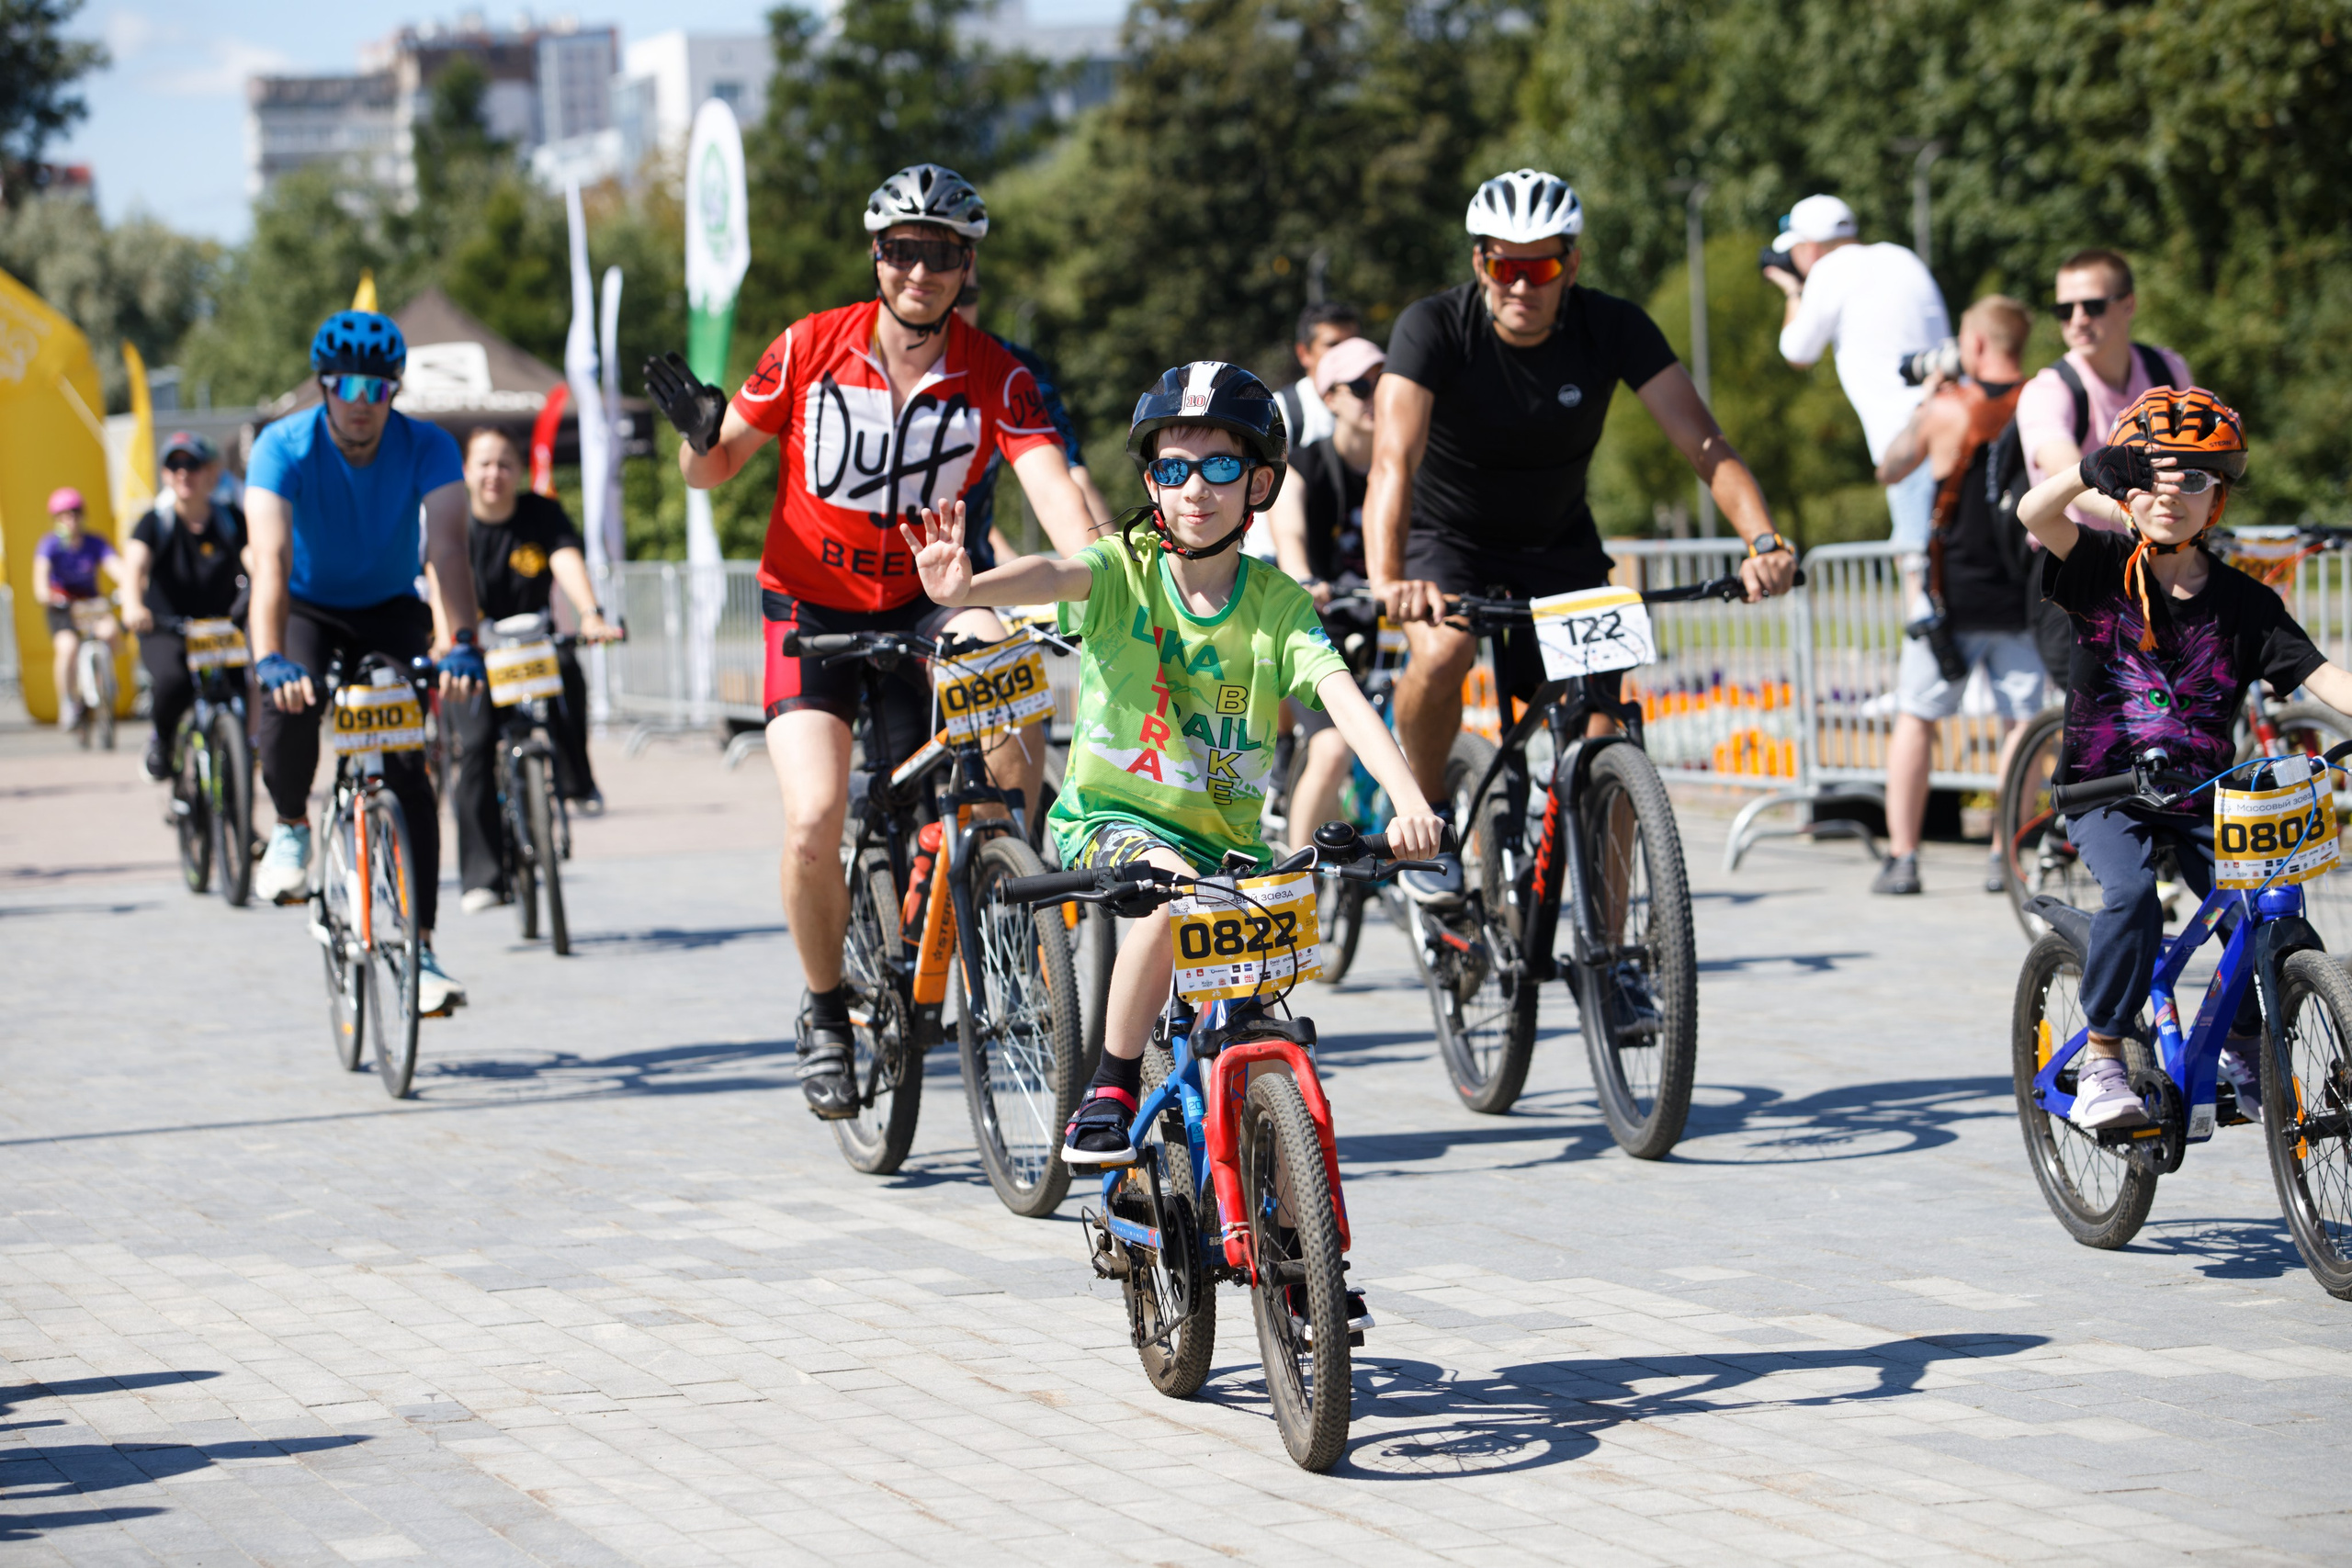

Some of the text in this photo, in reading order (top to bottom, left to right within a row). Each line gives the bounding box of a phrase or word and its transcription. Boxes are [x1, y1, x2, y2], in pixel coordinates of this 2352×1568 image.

[1186, 394, 1205, 407] 10
[816, 369, 974, 529] Duff
[821, 537, 917, 577] BEE
[1131, 604, 1226, 681] LKA
[1561, 610, 1625, 646] 122
[945, 664, 1035, 712] 0809
[1126, 626, 1171, 783] TRA
[339, 706, 402, 729] 0910
[2237, 799, 2291, 813] Массовый
[2222, 807, 2325, 853] 0808
[1261, 889, 1294, 901] заезд
[1180, 911, 1298, 960] 0822
[1188, 1101, 1202, 1111] 20
